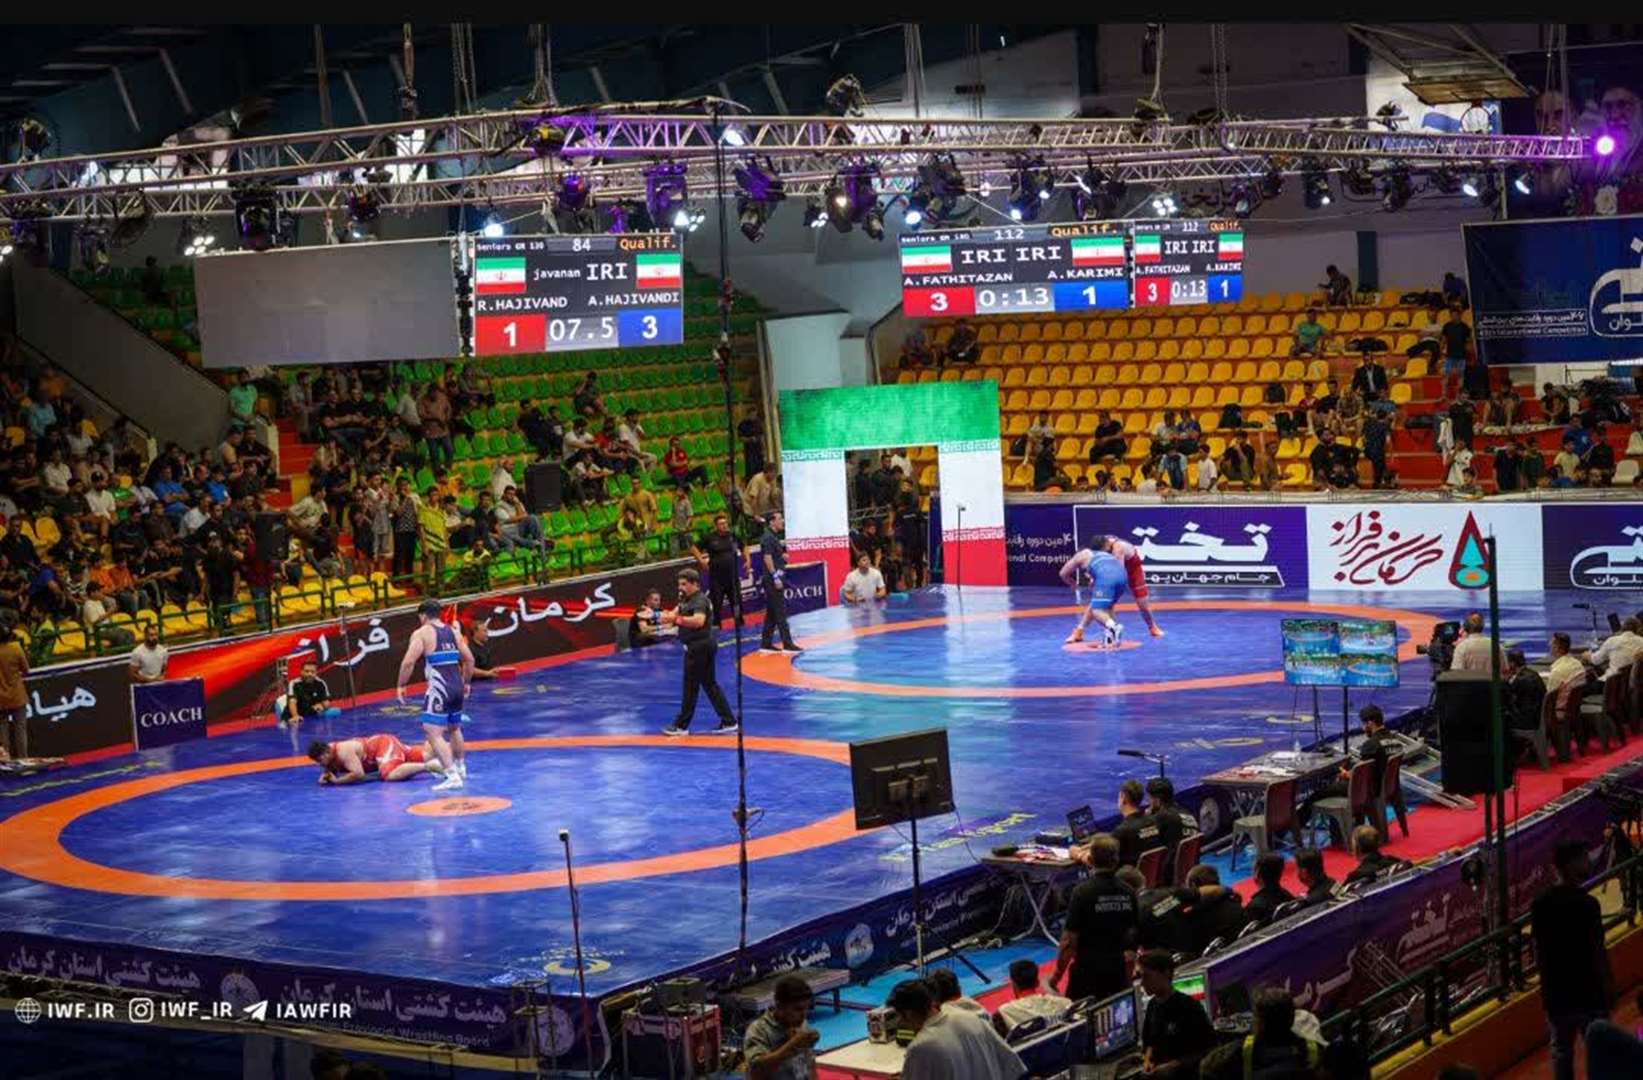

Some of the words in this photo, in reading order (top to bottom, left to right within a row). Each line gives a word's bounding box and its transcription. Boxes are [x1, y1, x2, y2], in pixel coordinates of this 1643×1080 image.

[995, 229, 1024, 240] 112
[1051, 224, 1117, 238] Qualif.
[1182, 222, 1198, 232] 112
[572, 238, 591, 252] 84
[620, 237, 676, 250] Qualif.
[1164, 241, 1188, 254] IRI
[1192, 240, 1215, 253] IRI
[961, 249, 1006, 264] IRI
[1015, 246, 1061, 261] IRI
[533, 268, 580, 281] javanan
[586, 263, 628, 281] IRI
[904, 273, 1013, 286] A.FATHITAZAN
[1047, 267, 1124, 280] A.KARIMI
[1083, 285, 1097, 305] 1
[1148, 283, 1158, 302] 3
[1172, 280, 1206, 298] 0:13
[1221, 279, 1229, 298] 1
[478, 297, 568, 311] R.HAJIVAND
[588, 292, 680, 306] A.HAJIVANDI
[930, 292, 948, 312] 3
[979, 288, 1049, 307] 0:13
[503, 322, 517, 347] 1
[550, 317, 613, 341] 07.5
[642, 315, 658, 339] 3
[783, 585, 823, 600] OACH
[140, 706, 202, 728] COACH
